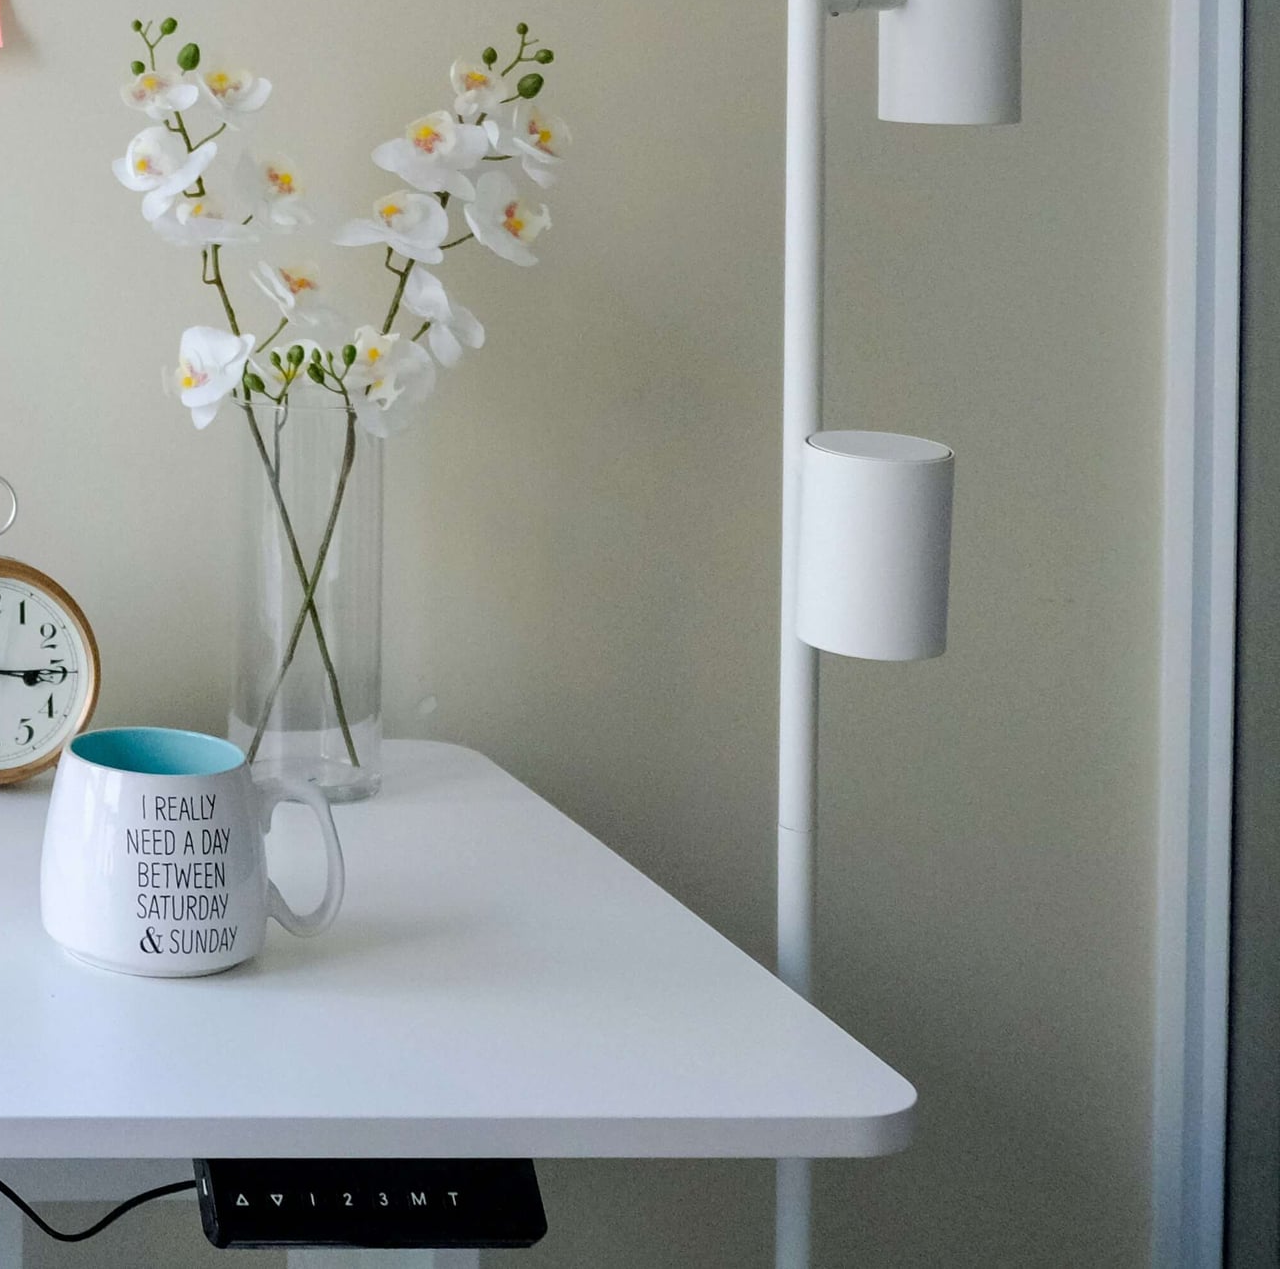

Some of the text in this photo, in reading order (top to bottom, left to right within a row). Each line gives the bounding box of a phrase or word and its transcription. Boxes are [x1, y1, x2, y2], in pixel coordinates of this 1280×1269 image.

[17, 599, 26, 626] 1
[39, 622, 57, 649] 2
[37, 692, 58, 719] 4
[14, 718, 34, 746] 5
[141, 793, 217, 822] I REALLY
[125, 827, 231, 856] NEED A DAY
[137, 861, 226, 889] BETWEEN
[136, 892, 229, 922] SATURDAY
[139, 925, 238, 955] & SUNDAY
[343, 1192, 354, 1206] 2
[378, 1192, 389, 1206] 3
[410, 1192, 427, 1207] M
[447, 1191, 459, 1207] T
